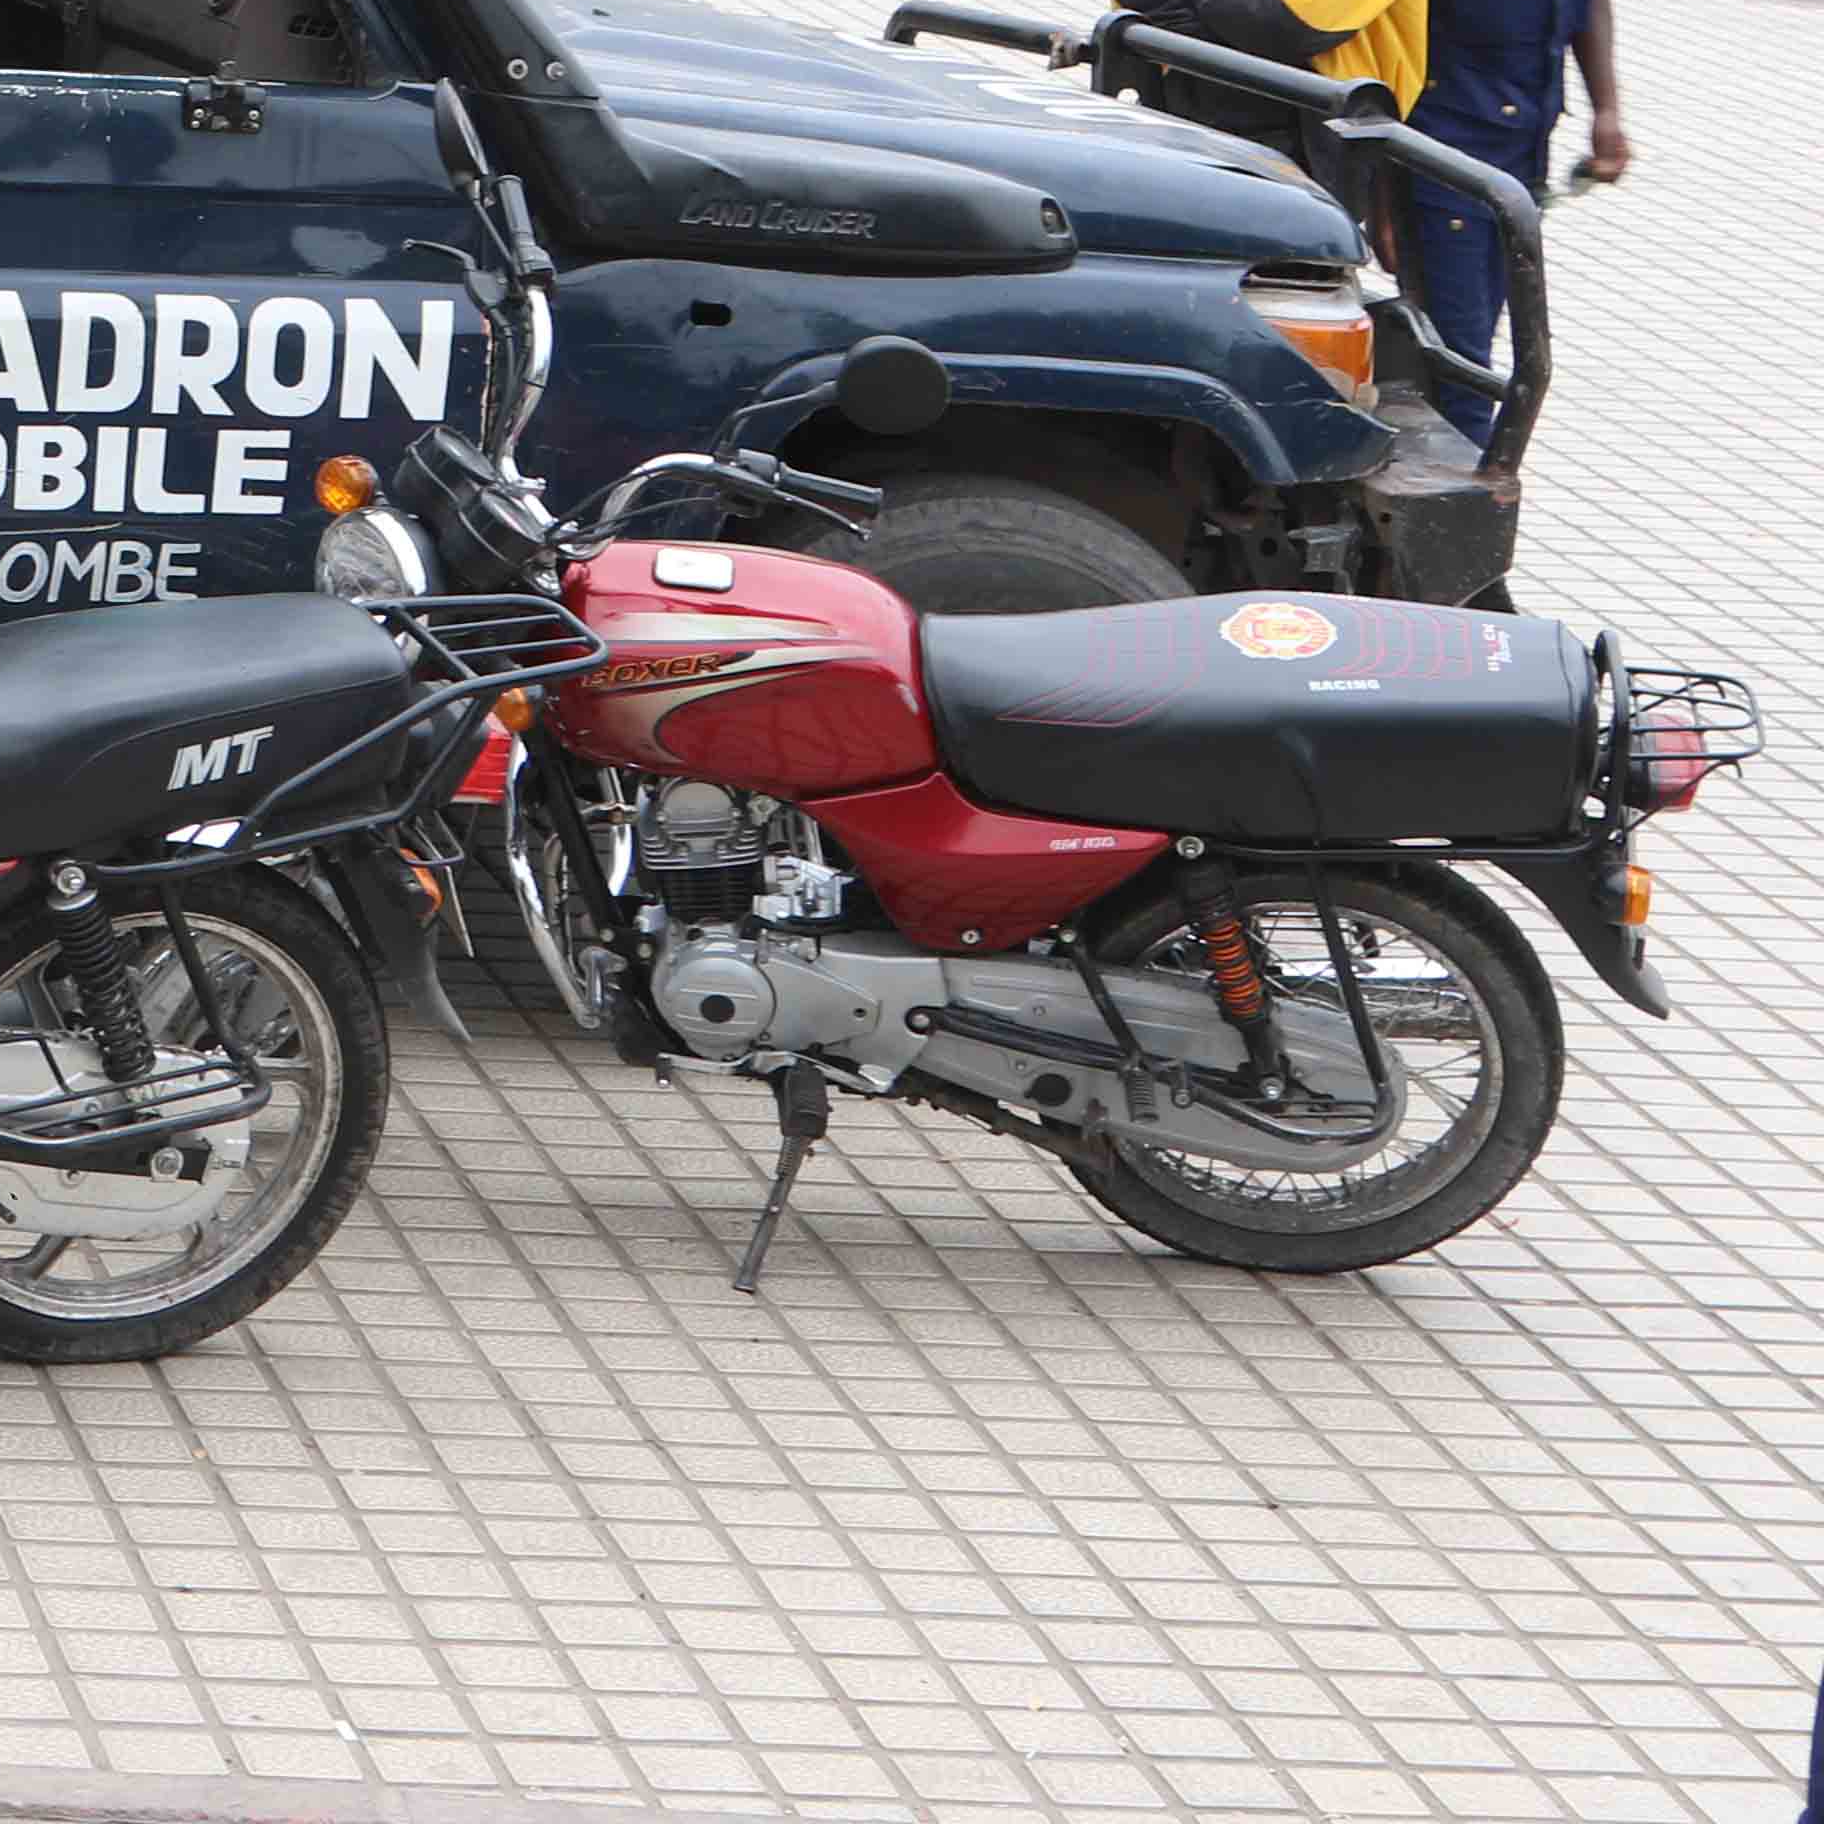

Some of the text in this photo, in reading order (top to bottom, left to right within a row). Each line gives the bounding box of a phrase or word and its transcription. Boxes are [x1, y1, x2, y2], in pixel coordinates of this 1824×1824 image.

[679, 194, 877, 239] LAND CRUISER
[1308, 679, 1381, 692] RACING
[166, 725, 276, 792] MT
